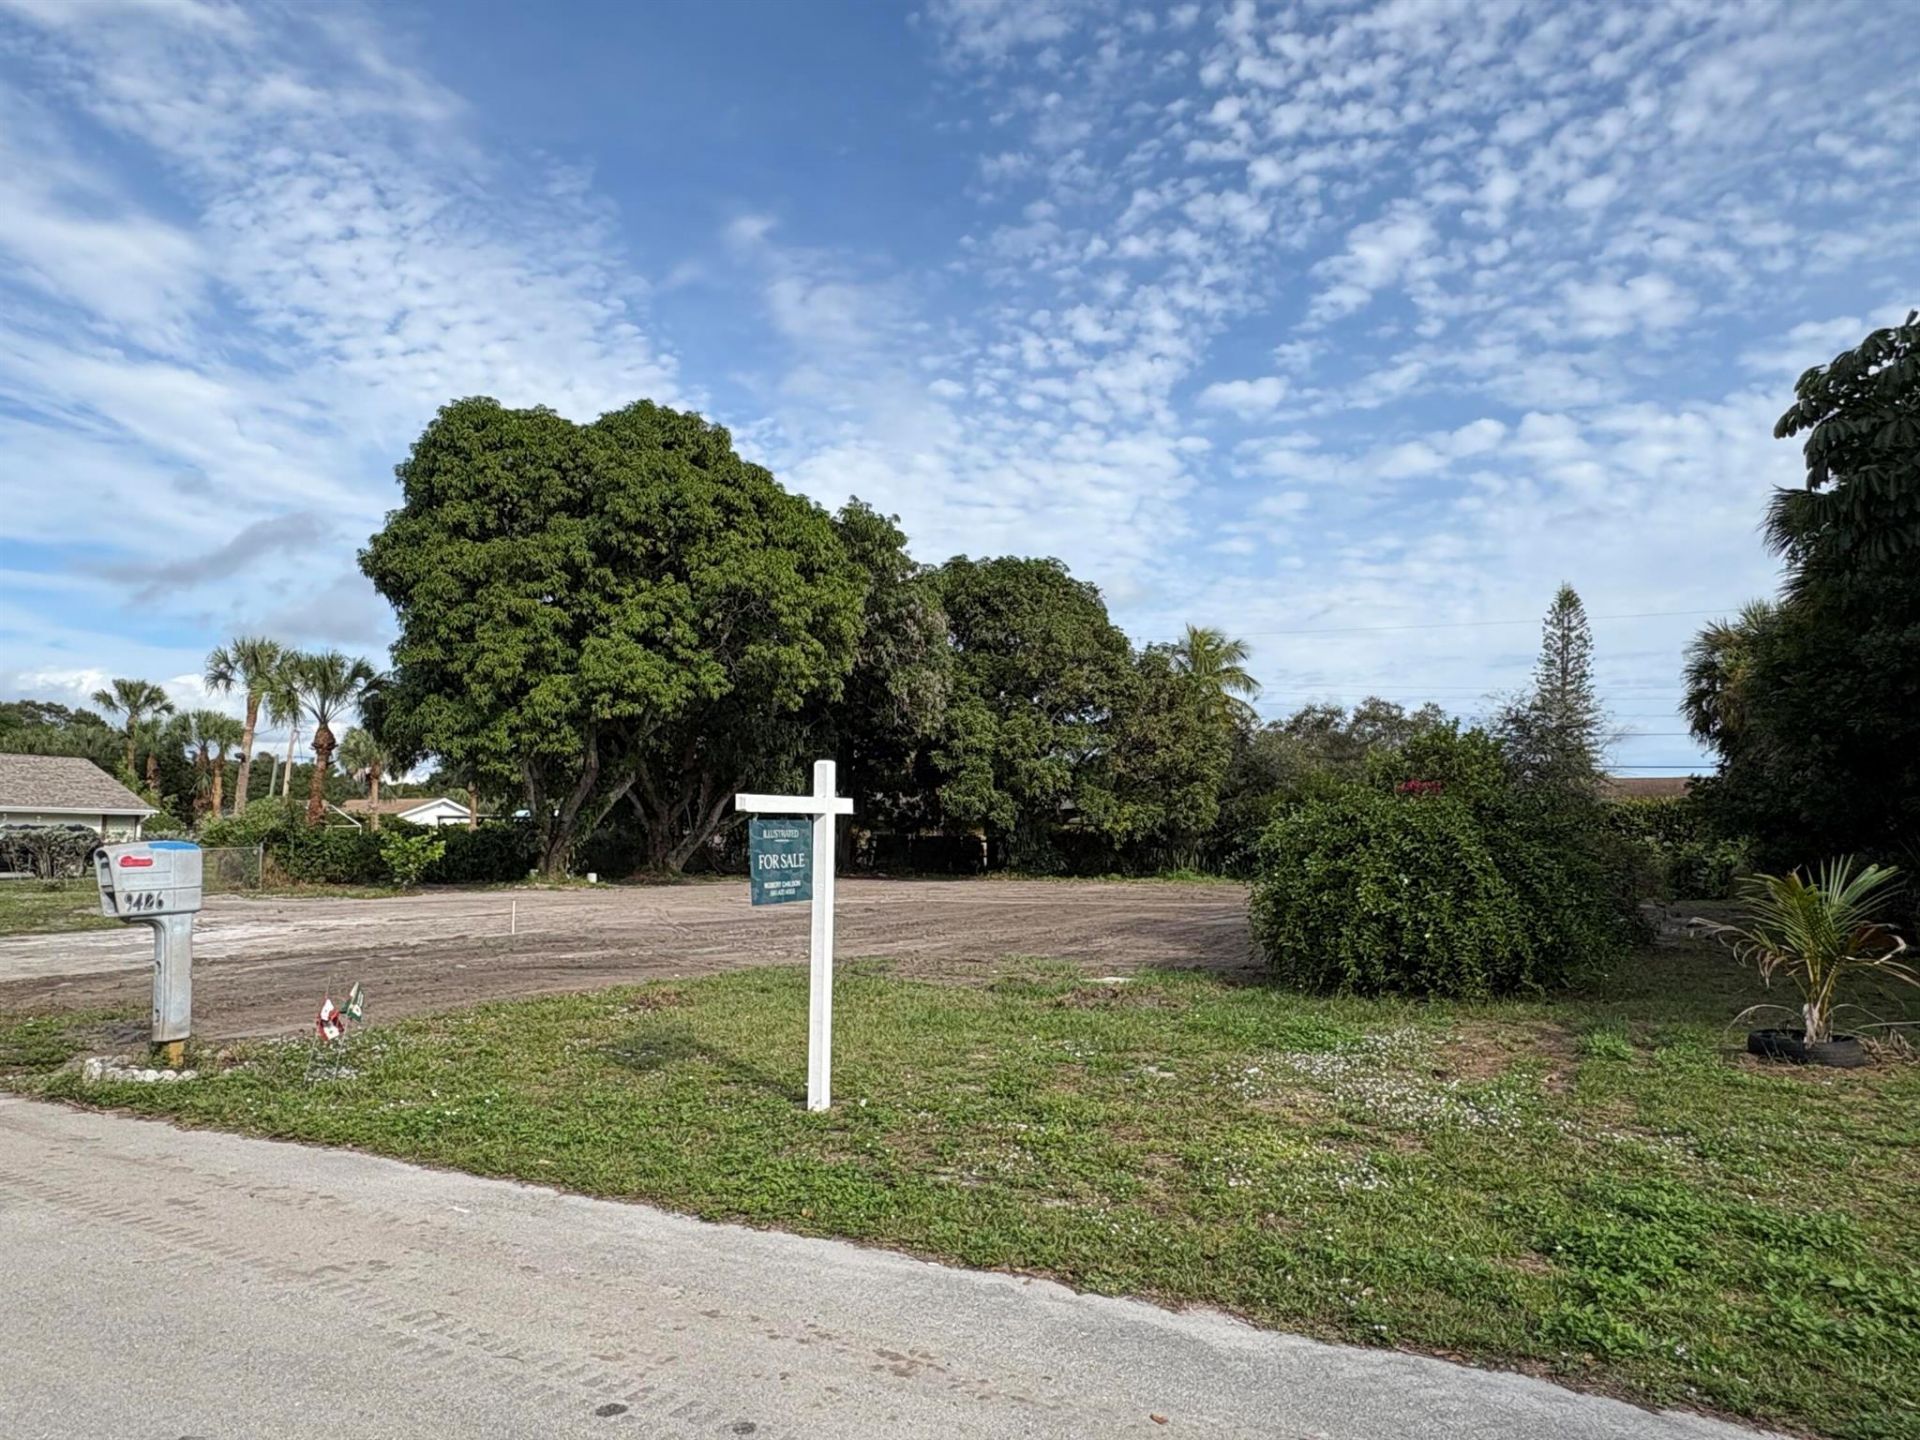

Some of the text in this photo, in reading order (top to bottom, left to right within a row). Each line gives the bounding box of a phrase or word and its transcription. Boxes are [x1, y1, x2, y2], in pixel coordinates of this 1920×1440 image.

[763, 829, 799, 838] ILLUSTRATED
[758, 853, 805, 870] FOR SALE
